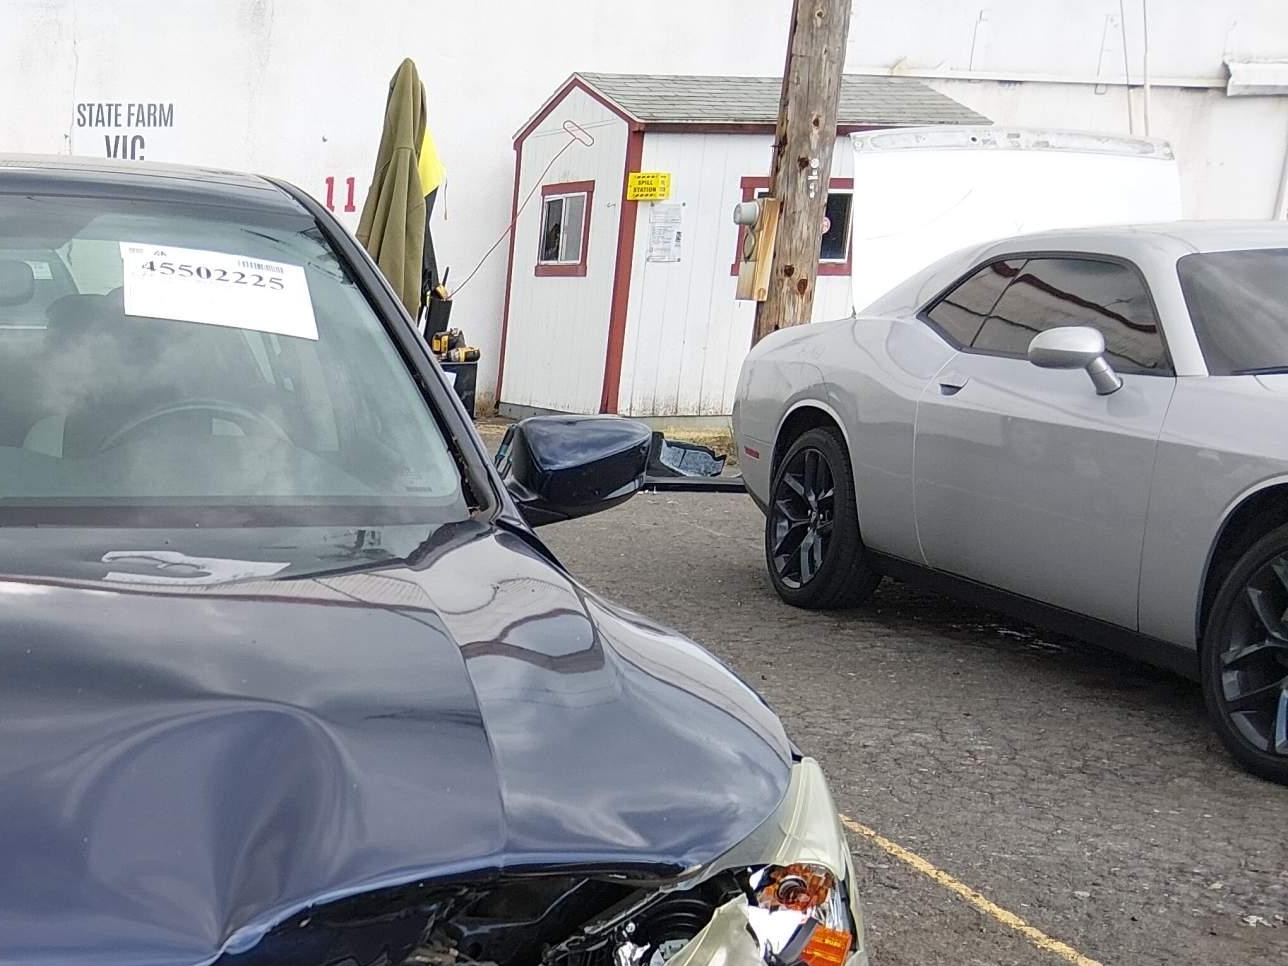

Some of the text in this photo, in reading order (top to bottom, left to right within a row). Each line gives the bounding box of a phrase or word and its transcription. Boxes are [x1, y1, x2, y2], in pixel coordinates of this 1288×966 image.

[77, 104, 174, 127] STATE FARM
[105, 135, 145, 160] VIC
[325, 176, 356, 213] 11
[142, 260, 286, 290] 45502225
